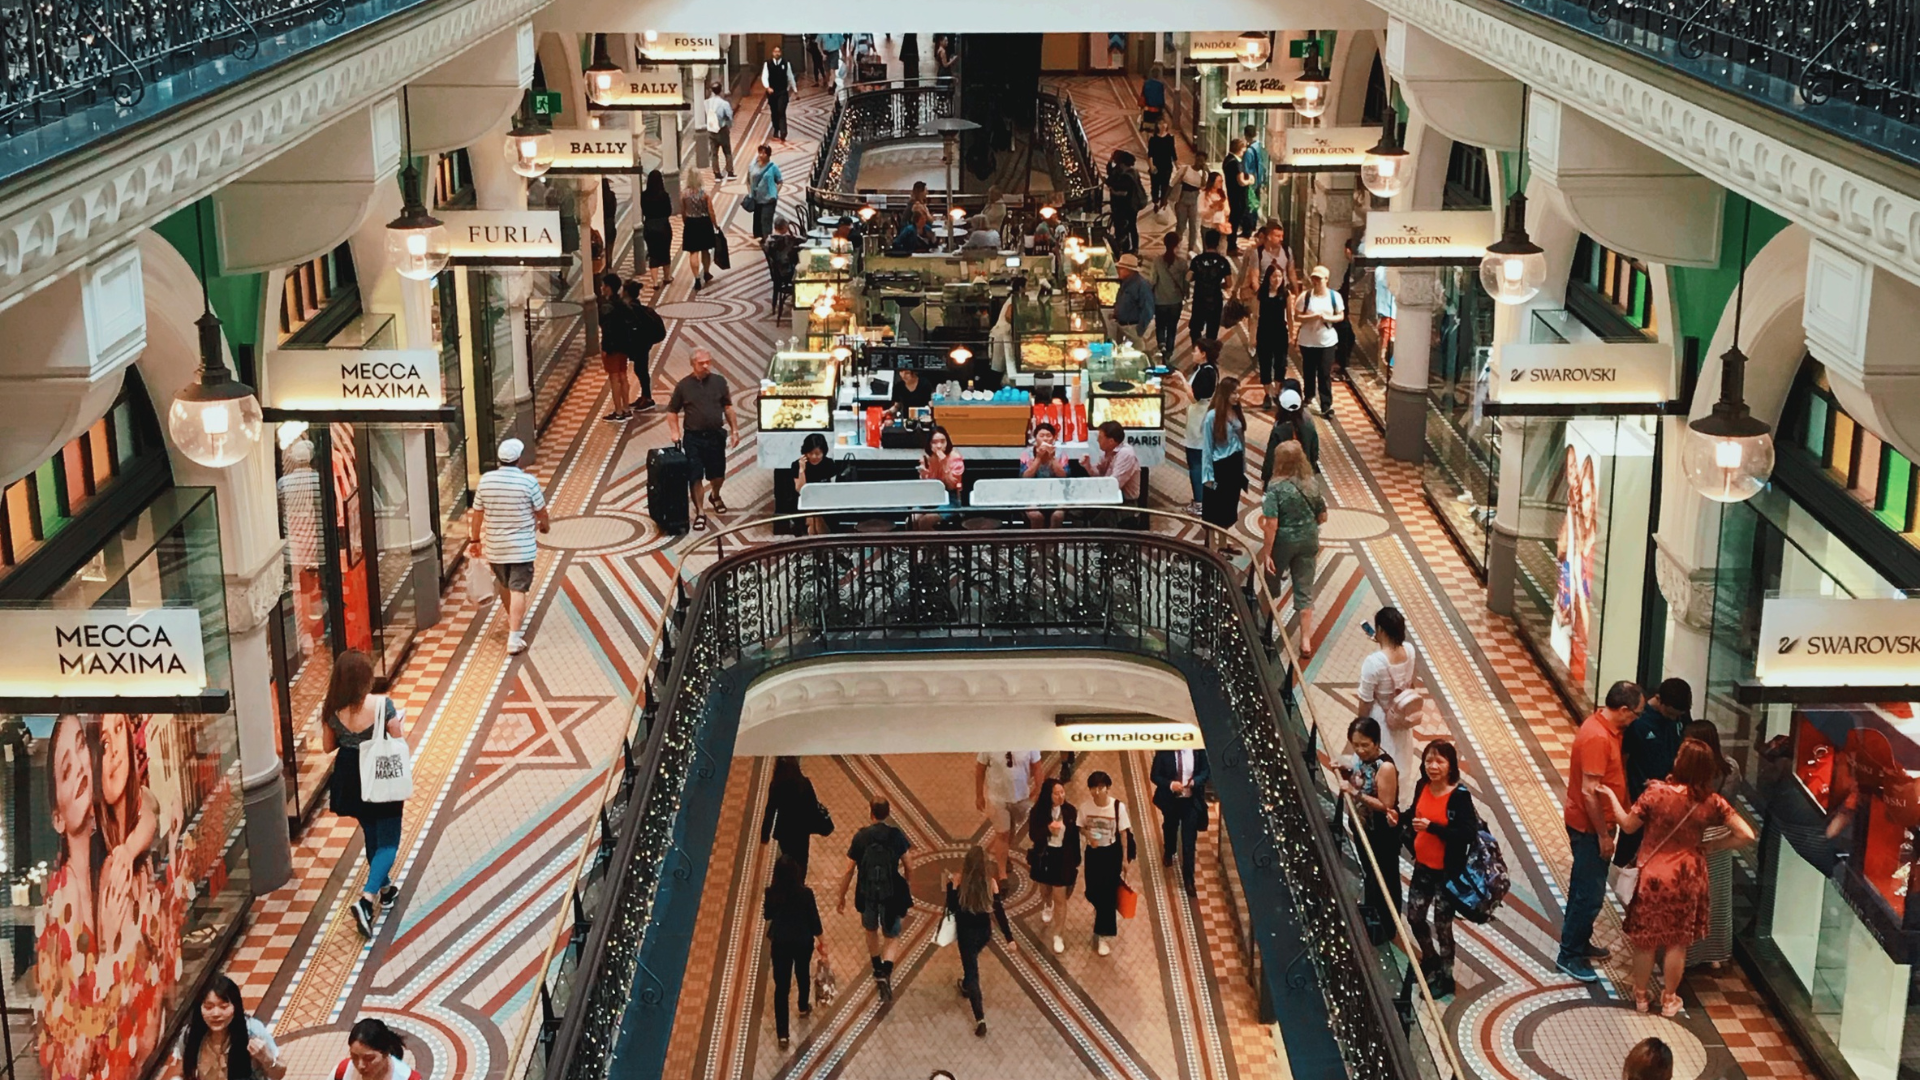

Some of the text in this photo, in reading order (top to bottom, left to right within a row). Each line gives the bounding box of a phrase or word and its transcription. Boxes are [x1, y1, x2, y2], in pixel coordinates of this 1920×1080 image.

[674, 38, 715, 47] FOSSIL
[630, 83, 678, 94] BALLY
[1236, 78, 1286, 96] Folli Follie
[570, 142, 627, 154] BALLY
[1292, 147, 1319, 155] RODD
[468, 225, 553, 243] FURLA
[1374, 236, 1451, 245] RODD & GUNN
[341, 362, 421, 379] MECCA
[1530, 368, 1616, 382] SWAROVSKI
[342, 382, 430, 398] MAXIMA
[1127, 435, 1161, 446] PARISI
[55, 624, 172, 648] MECCA
[58, 652, 187, 674] MAXIMA
[1070, 732, 1194, 743] dermalogica
[375, 759, 403, 771] FARERS
